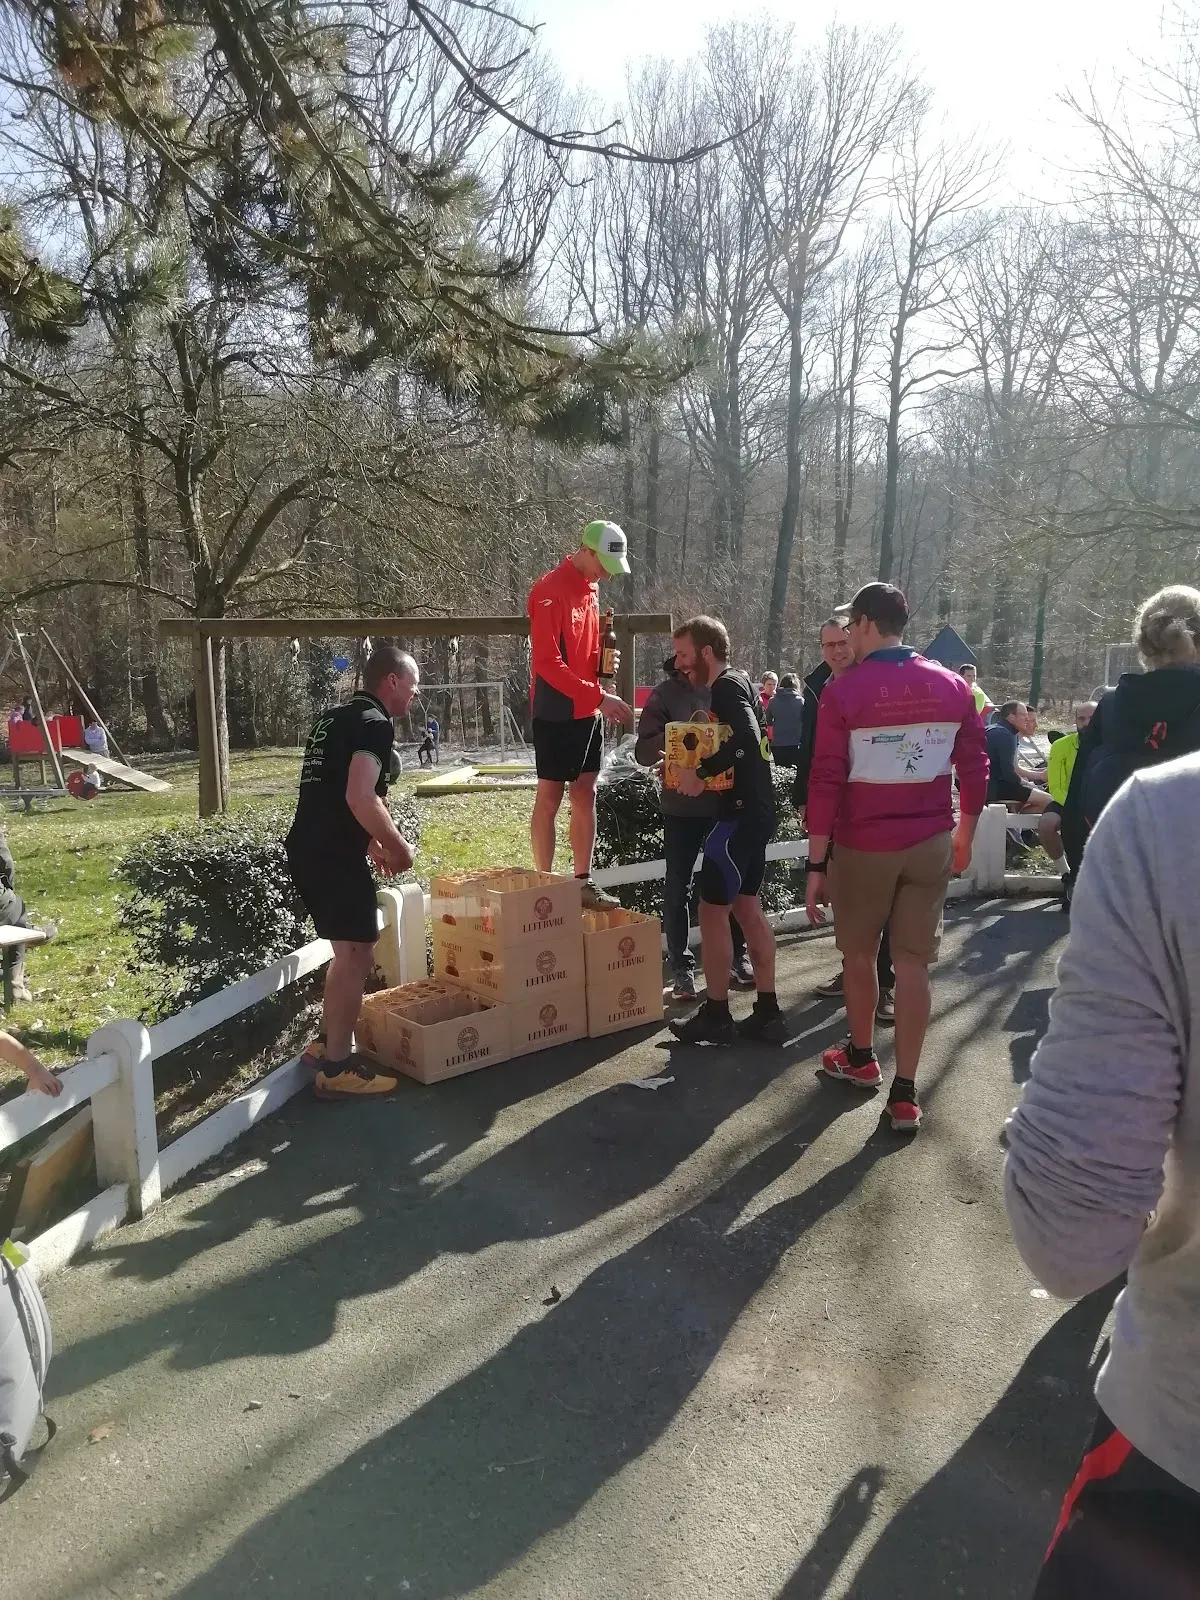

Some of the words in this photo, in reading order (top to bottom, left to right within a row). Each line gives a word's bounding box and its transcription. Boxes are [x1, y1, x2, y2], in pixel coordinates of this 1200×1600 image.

[523, 916, 566, 933] LEFEBVRE
[607, 955, 647, 971] LEFEBVRE
[526, 970, 568, 987] LEFEBVRE
[608, 1005, 647, 1023] LEFEBVRE
[528, 1023, 569, 1042] LEFEBVRE
[445, 1046, 492, 1067] LEFEBVRE
